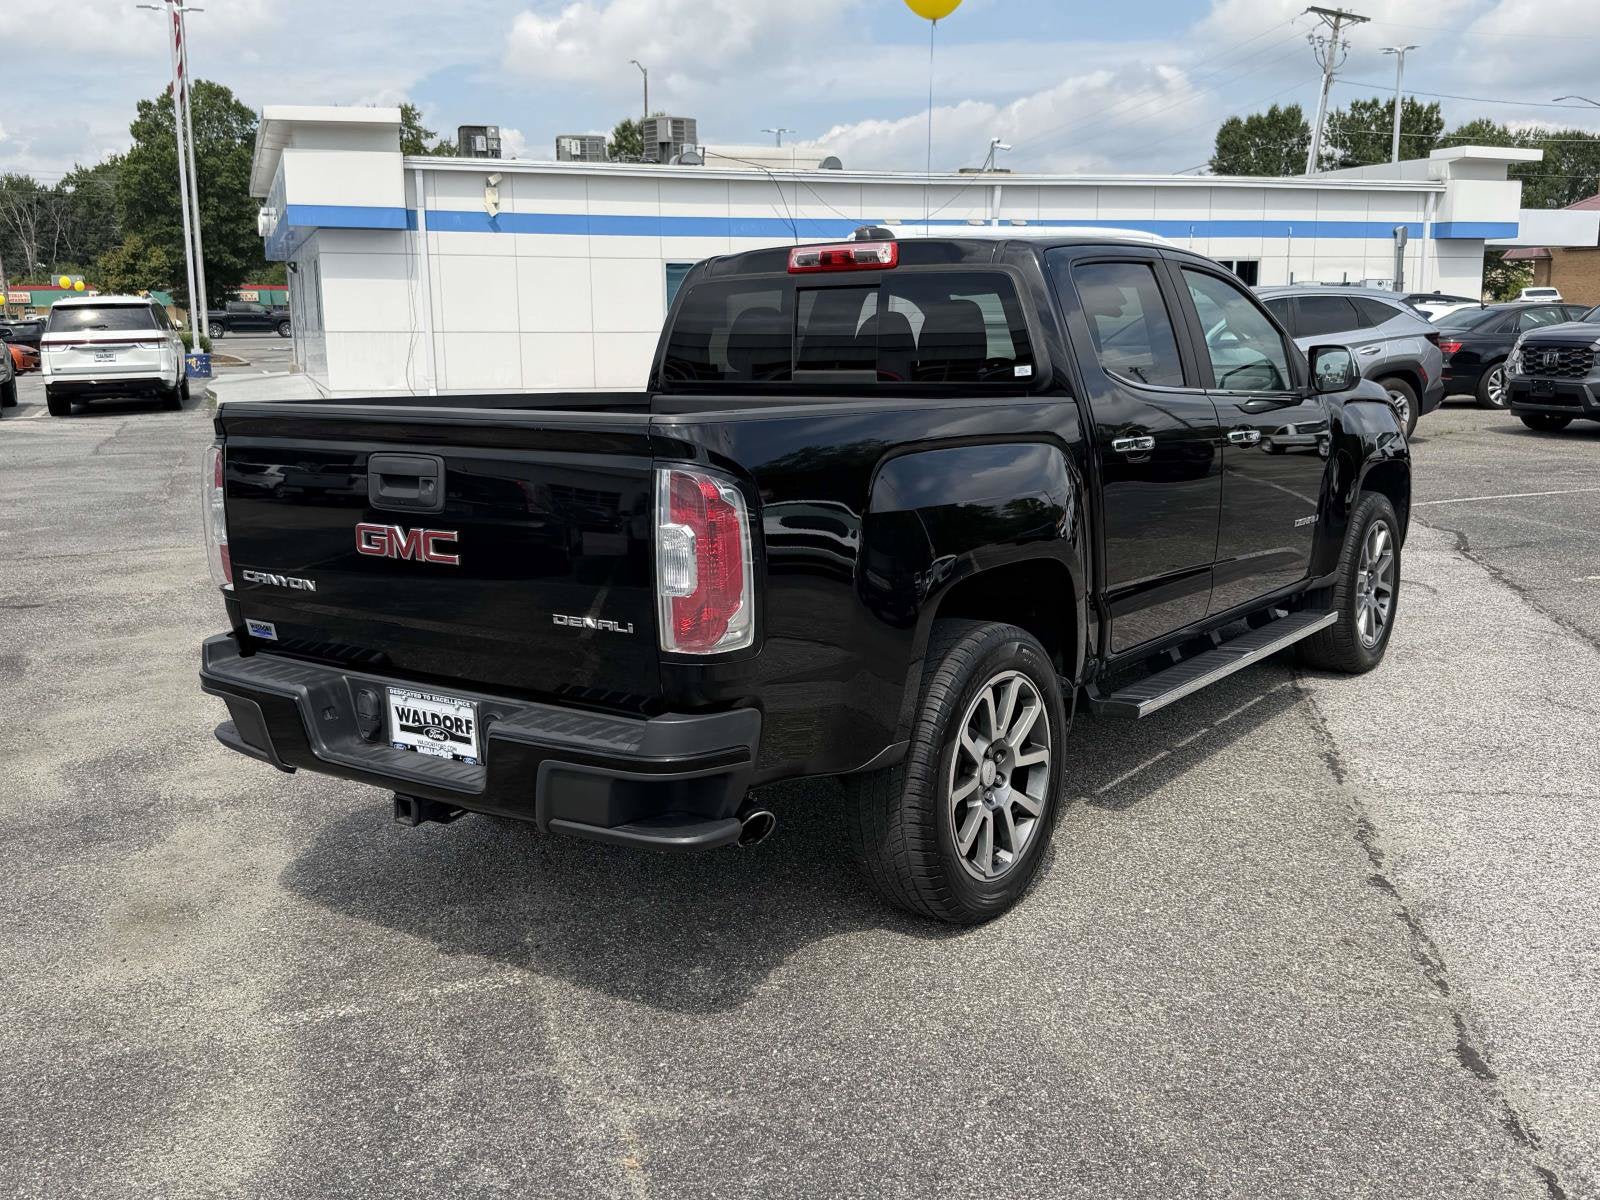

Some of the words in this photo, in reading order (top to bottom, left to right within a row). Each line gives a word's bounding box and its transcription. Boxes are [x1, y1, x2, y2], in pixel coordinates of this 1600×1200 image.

[355, 522, 460, 566] GMC
[243, 570, 316, 591] CANYON
[552, 613, 634, 634] DENALI
[389, 688, 421, 699] DEDICATED
[432, 696, 471, 708] EXCELLENCE
[395, 705, 473, 735] WALDORF
[428, 728, 446, 741] Ford
